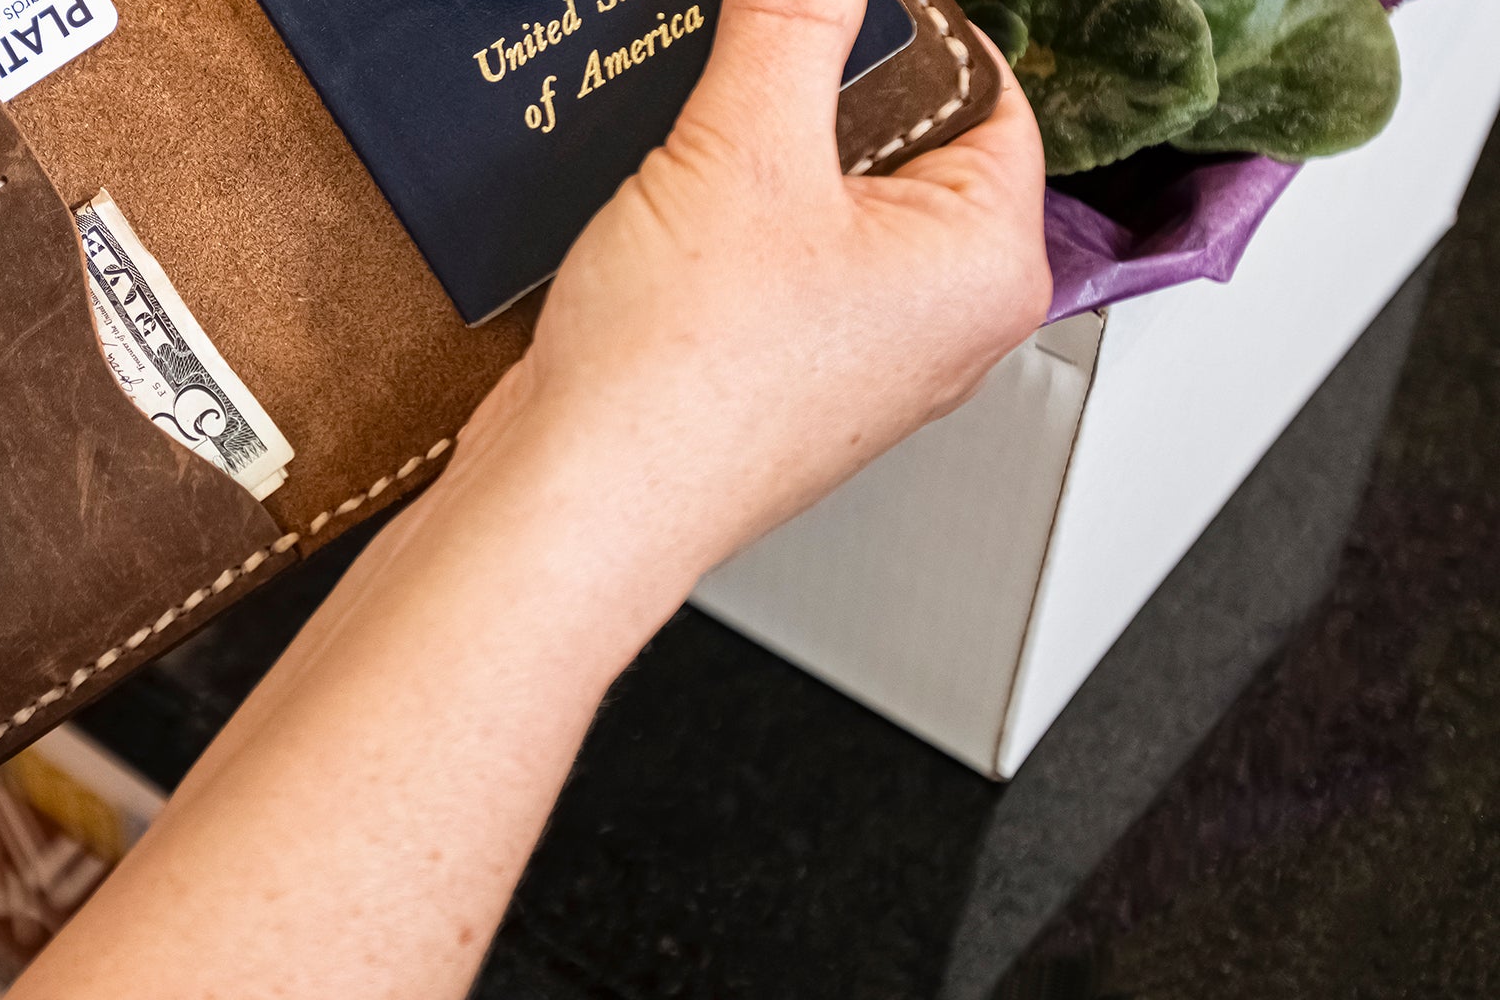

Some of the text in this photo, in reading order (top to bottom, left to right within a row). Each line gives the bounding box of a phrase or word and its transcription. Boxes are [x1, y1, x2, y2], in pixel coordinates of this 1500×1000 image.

[524, 4, 705, 133] of America
[81, 224, 177, 352] FIVE
[99, 305, 113, 326] United
[111, 324, 121, 336] the
[116, 333, 126, 343] of
[122, 342, 146, 372] Treasurer
